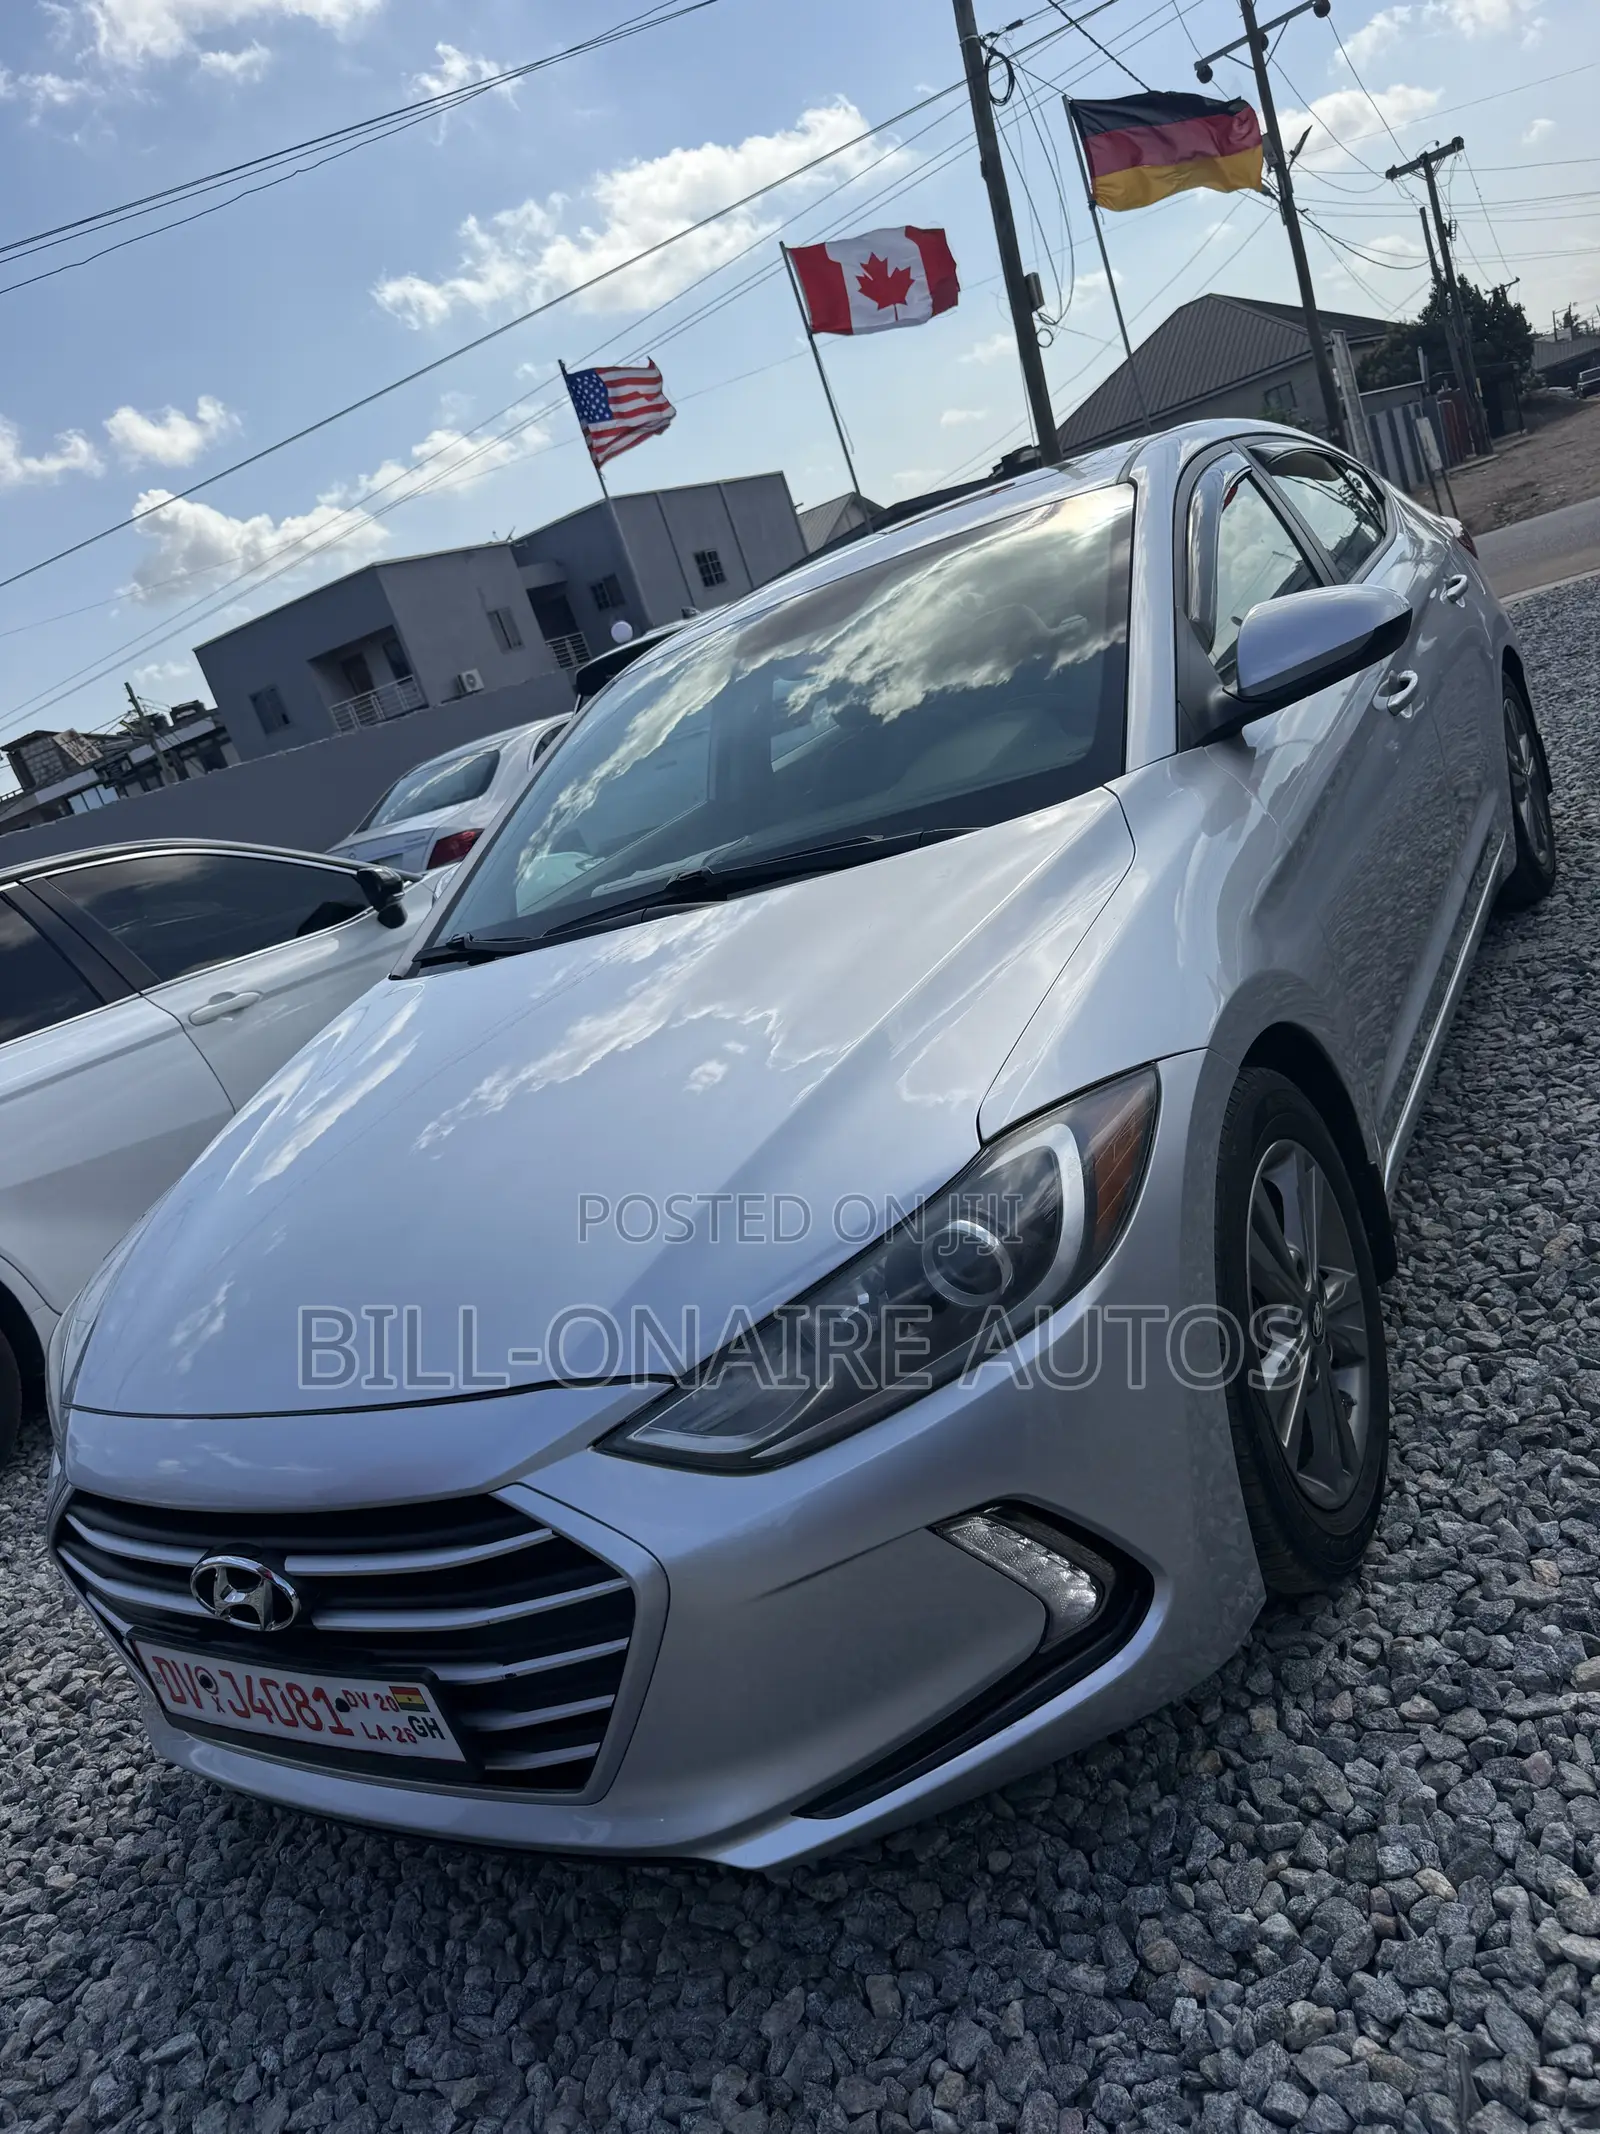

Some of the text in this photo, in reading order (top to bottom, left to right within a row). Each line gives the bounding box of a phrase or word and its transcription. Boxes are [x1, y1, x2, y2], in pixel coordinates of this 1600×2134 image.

[151, 1655, 204, 1710] DV
[341, 1689, 400, 1713] DV 20
[360, 1720, 418, 1745] LA 26
[408, 1715, 446, 1740] GH
